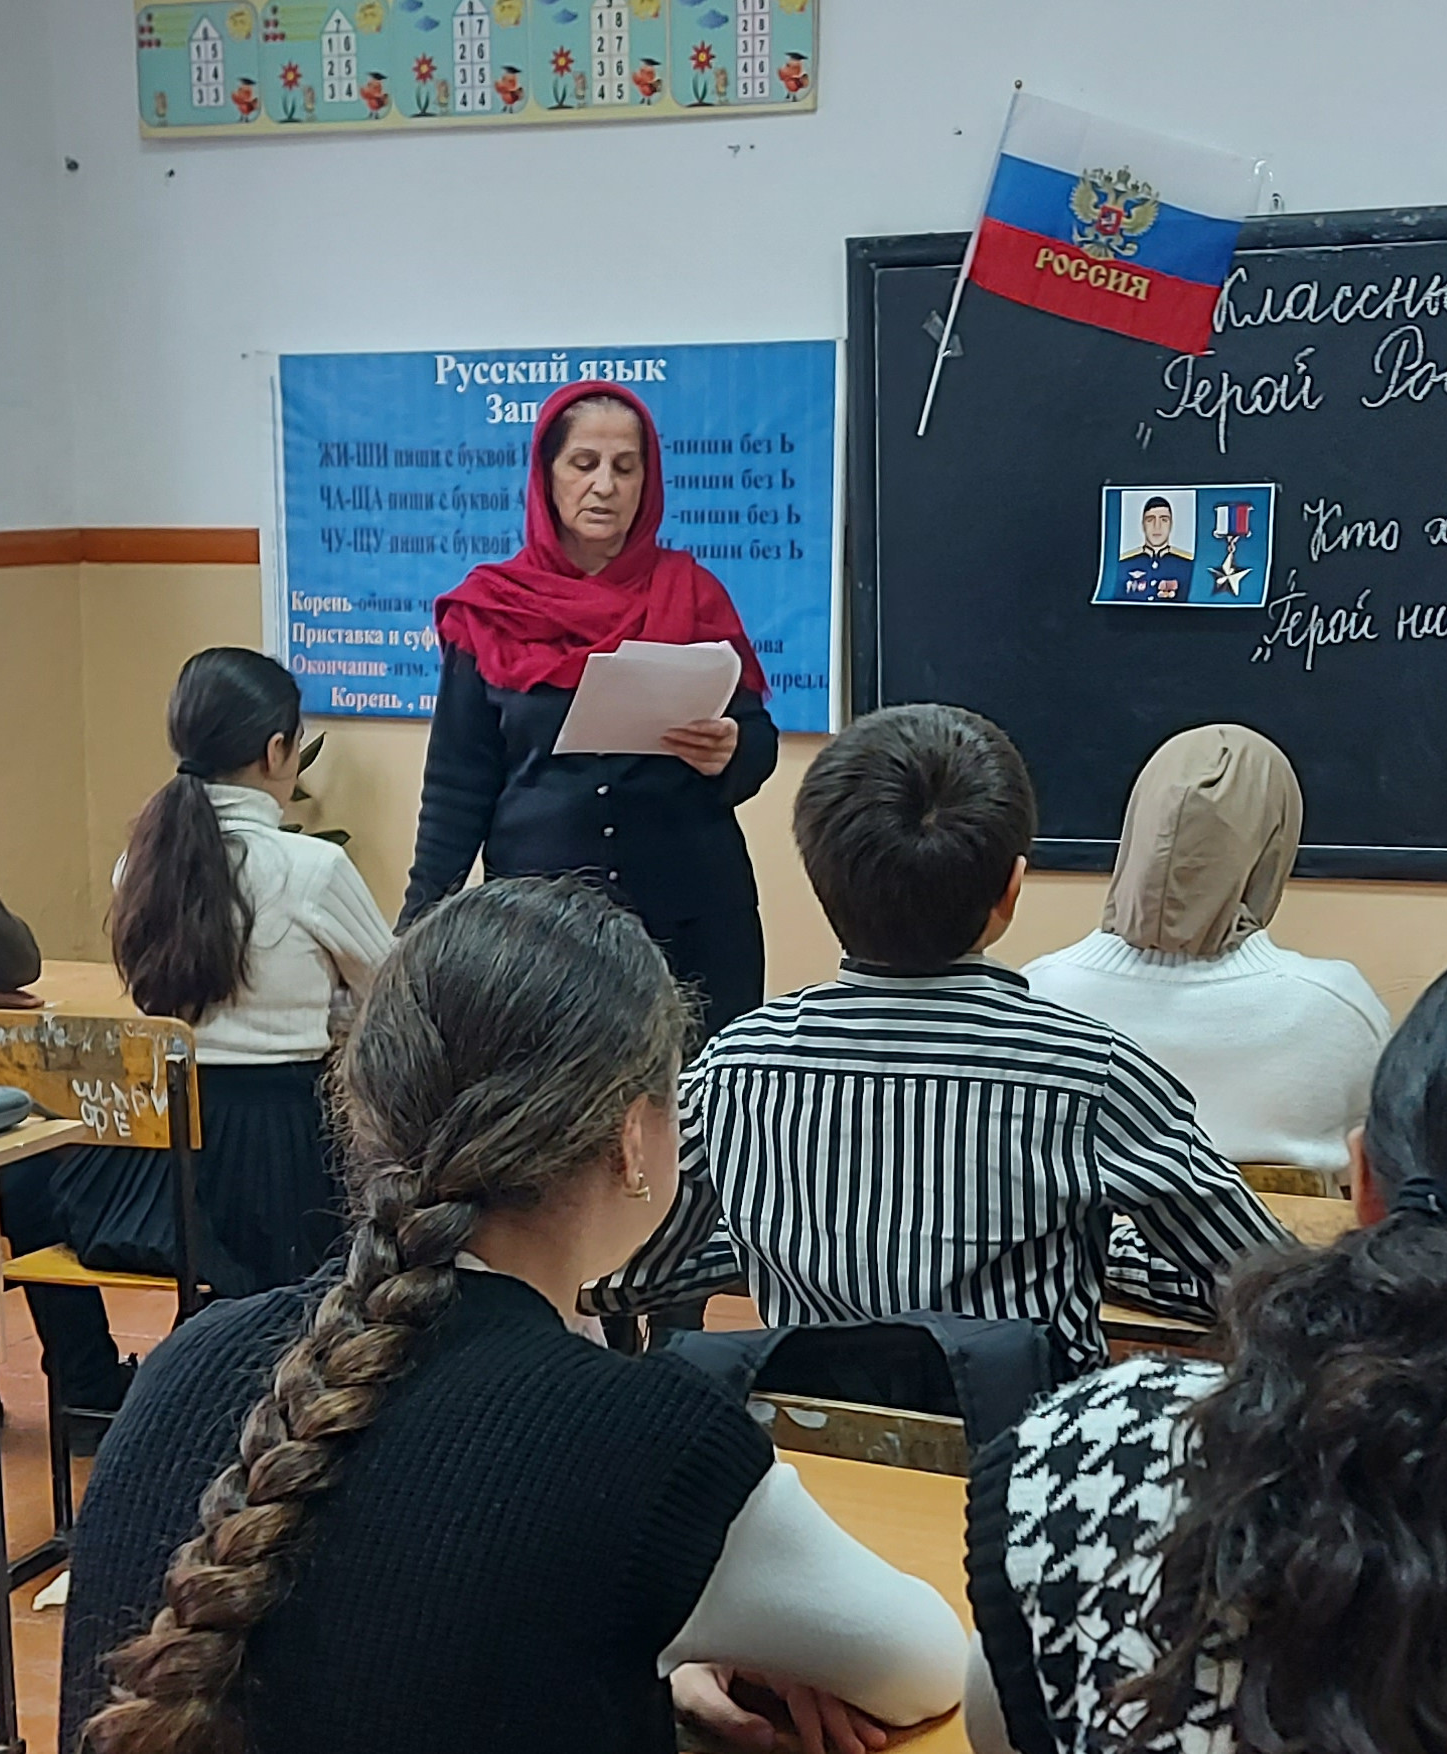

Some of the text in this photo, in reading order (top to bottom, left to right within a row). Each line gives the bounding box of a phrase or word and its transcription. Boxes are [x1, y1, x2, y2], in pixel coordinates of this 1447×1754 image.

[459, 18, 484, 36] 1 7
[597, 12, 623, 29] 1 8
[742, 19, 749, 32] 2
[327, 36, 334, 53] 1
[458, 42, 485, 61] 2 6
[596, 35, 624, 53] 2 7
[758, 39, 765, 52] 7
[327, 59, 352, 77] 2 5
[459, 66, 486, 85] 3 5
[597, 60, 624, 77] 3 6
[741, 61, 749, 74] 4
[328, 82, 353, 100] 3 4
[597, 83, 625, 100] 4 5
[742, 81, 765, 96] 5 5
[459, 90, 486, 108] 4 4
[1034, 247, 1151, 301] РОССИЯ
[434, 351, 667, 393] Русский язык
[739, 432, 773, 455] без
[318, 440, 389, 469] ЖИ-ШИ
[393, 447, 441, 469] пиши
[457, 442, 517, 475] буквой
[740, 468, 774, 490] без
[319, 484, 384, 512] ЧА-ЩА
[388, 491, 435, 511] пиши
[452, 484, 510, 519] буквой
[746, 504, 779, 525] без
[320, 526, 385, 555] ЧУ-ЩУ
[389, 534, 436, 554] пиши
[453, 527, 511, 561] буквой
[749, 540, 782, 561] без
[292, 622, 385, 649] Приставка
[388, 630, 400, 646] и
